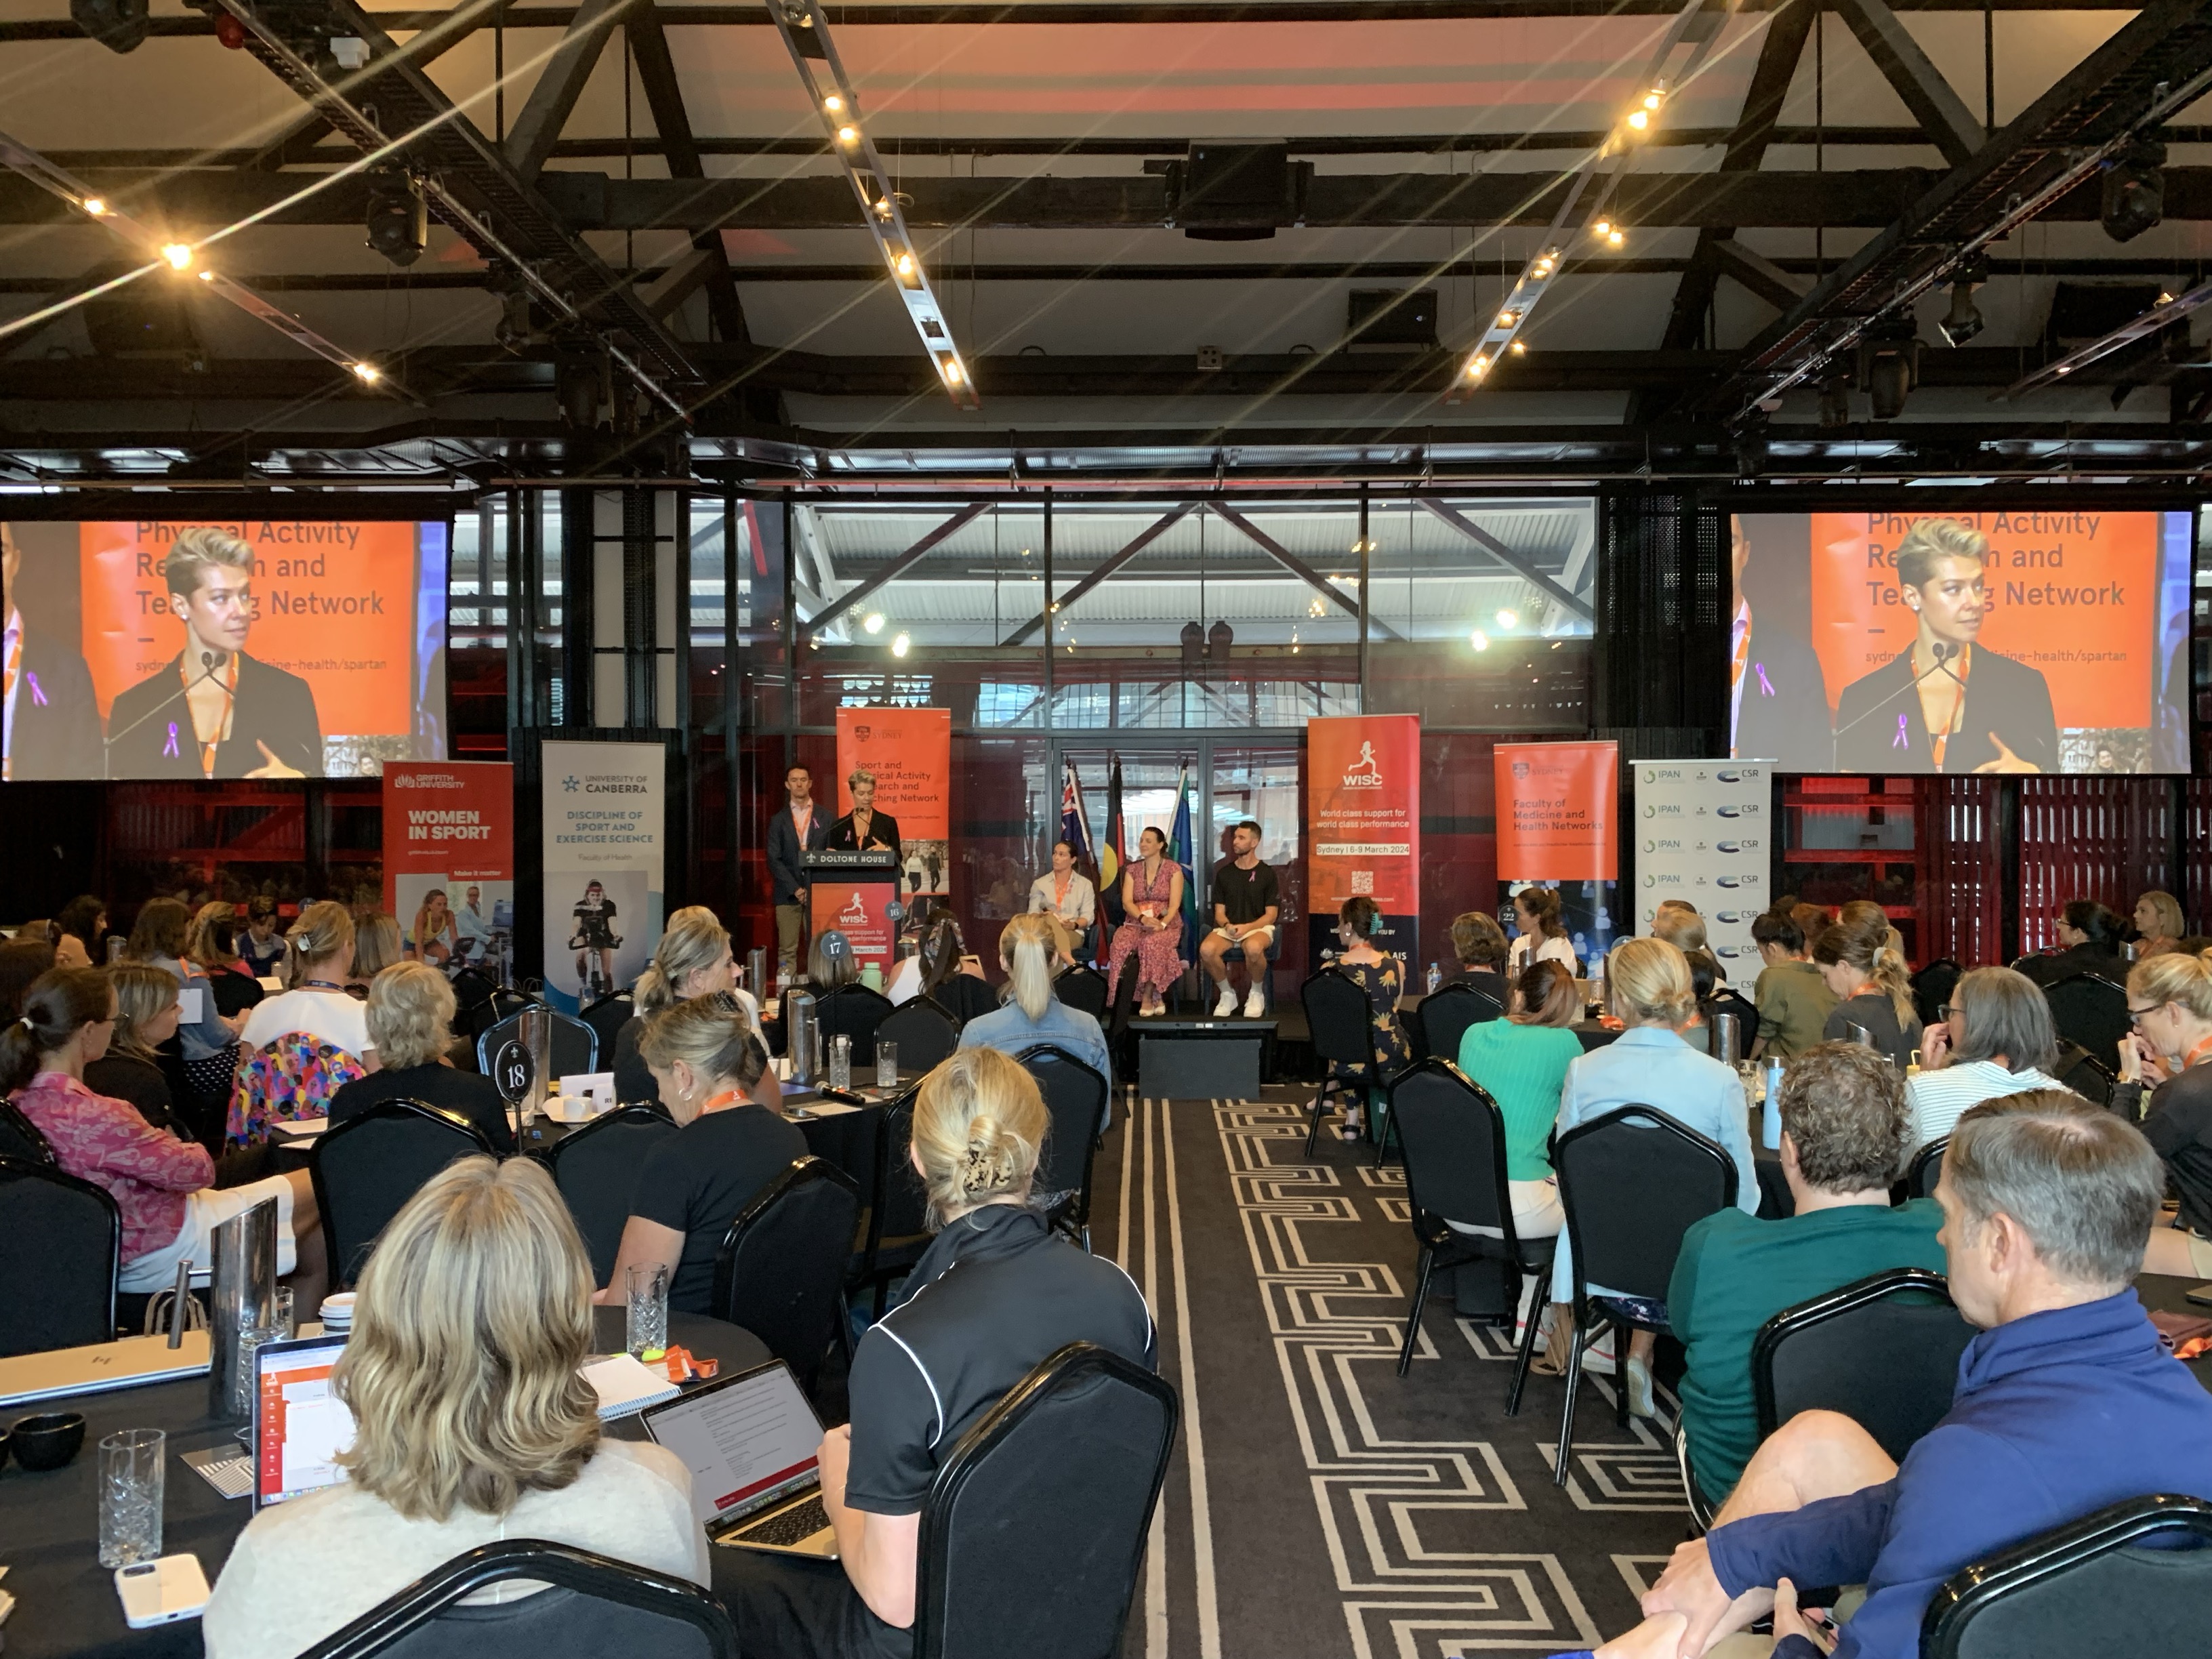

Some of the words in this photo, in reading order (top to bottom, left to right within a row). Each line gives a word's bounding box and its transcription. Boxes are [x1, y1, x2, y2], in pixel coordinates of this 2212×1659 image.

[1992, 513, 2101, 541] Activity
[258, 521, 361, 550] Activity
[2011, 543, 2063, 568] and
[276, 552, 325, 577] and
[2006, 581, 2125, 606] Network
[272, 590, 384, 615] Network
[855, 760, 881, 770] Sport
[884, 761, 901, 769] and
[874, 771, 893, 779] sical
[896, 771, 930, 781] Activity
[1658, 770, 1681, 779] IPAN
[1742, 769, 1759, 777] CSR
[1343, 775, 1382, 785] WISC
[586, 784, 648, 794] CANBERRA
[874, 781, 899, 790] earch
[902, 782, 919, 790] and
[873, 794, 897, 804] ching
[900, 794, 939, 802] Network
[1513, 799, 1552, 810] Faculty
[1555, 798, 1565, 808] of
[1742, 804, 1759, 813] CSR
[1342, 809, 1362, 817] class
[1364, 810, 1393, 818] support
[1395, 808, 1406, 817] for
[1658, 805, 1681, 813] IPAN
[408, 810, 480, 824] WOMEN
[567, 811, 626, 819] DISCIPLINE
[628, 811, 643, 819] OF
[1513, 811, 1561, 819] Medicine
[1565, 810, 1585, 819] and
[575, 823, 610, 832] SPORT
[611, 823, 635, 832] AND
[1338, 820, 1359, 828] class
[1360, 820, 1410, 829] performance
[1513, 821, 1549, 831] Health
[1552, 821, 1603, 830] Networks
[408, 825, 428, 840] IN
[431, 825, 491, 840] SPORT
[556, 835, 607, 843] EXERCISE
[609, 834, 653, 843] SCIENCE
[1658, 840, 1681, 848] IPAN
[1741, 840, 1759, 848] CSR
[1317, 845, 1344, 855] Sydney
[1364, 845, 1389, 853] March
[861, 855, 886, 863] HOUSE
[1658, 874, 1680, 883] IPAN
[1741, 875, 1759, 884] CSR
[890, 908, 899, 917] 16
[1503, 913, 1515, 921] 22
[1741, 910, 1759, 919] CSR
[840, 915, 868, 923] WISC
[830, 942, 841, 954] 17
[1741, 945, 1758, 954] CSR
[1392, 951, 1407, 960] AIS
[508, 1064, 525, 1088] 18
